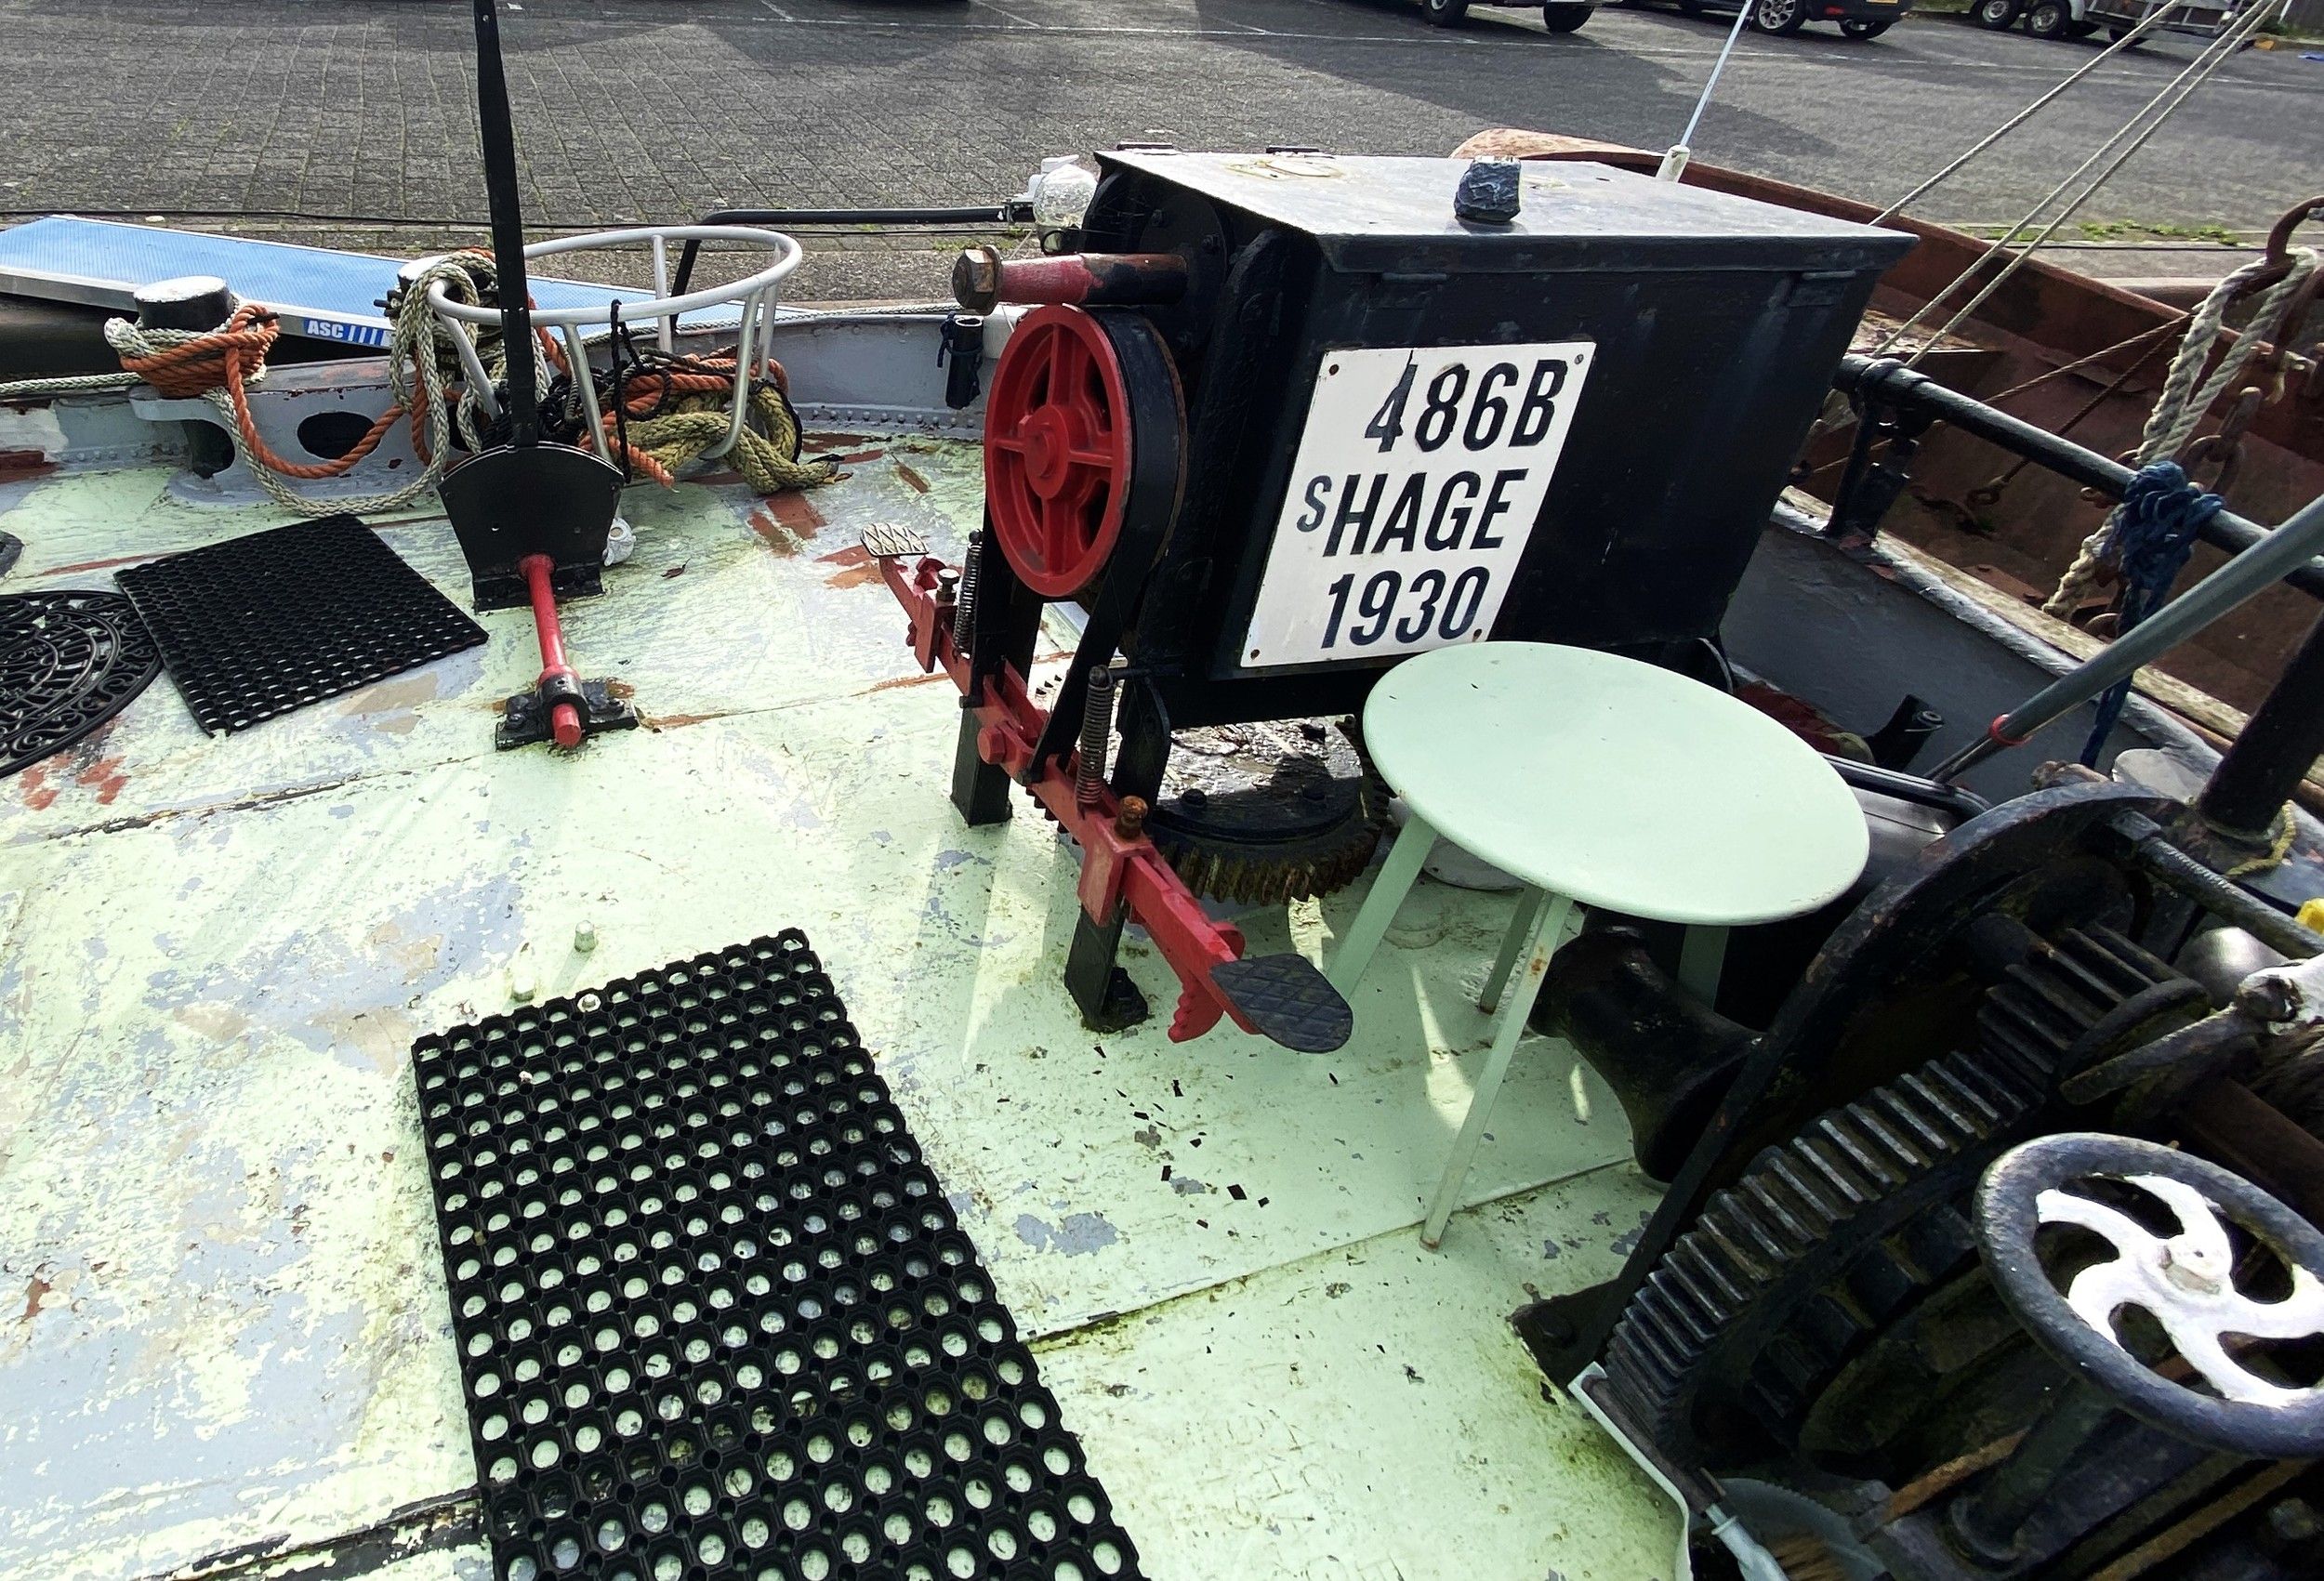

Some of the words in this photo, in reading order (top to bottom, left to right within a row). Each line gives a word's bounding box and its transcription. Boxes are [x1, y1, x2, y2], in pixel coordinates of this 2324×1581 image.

[307, 320, 345, 338] ASC
[1364, 359, 1568, 454] 486B
[1320, 565, 1491, 650] 1930
